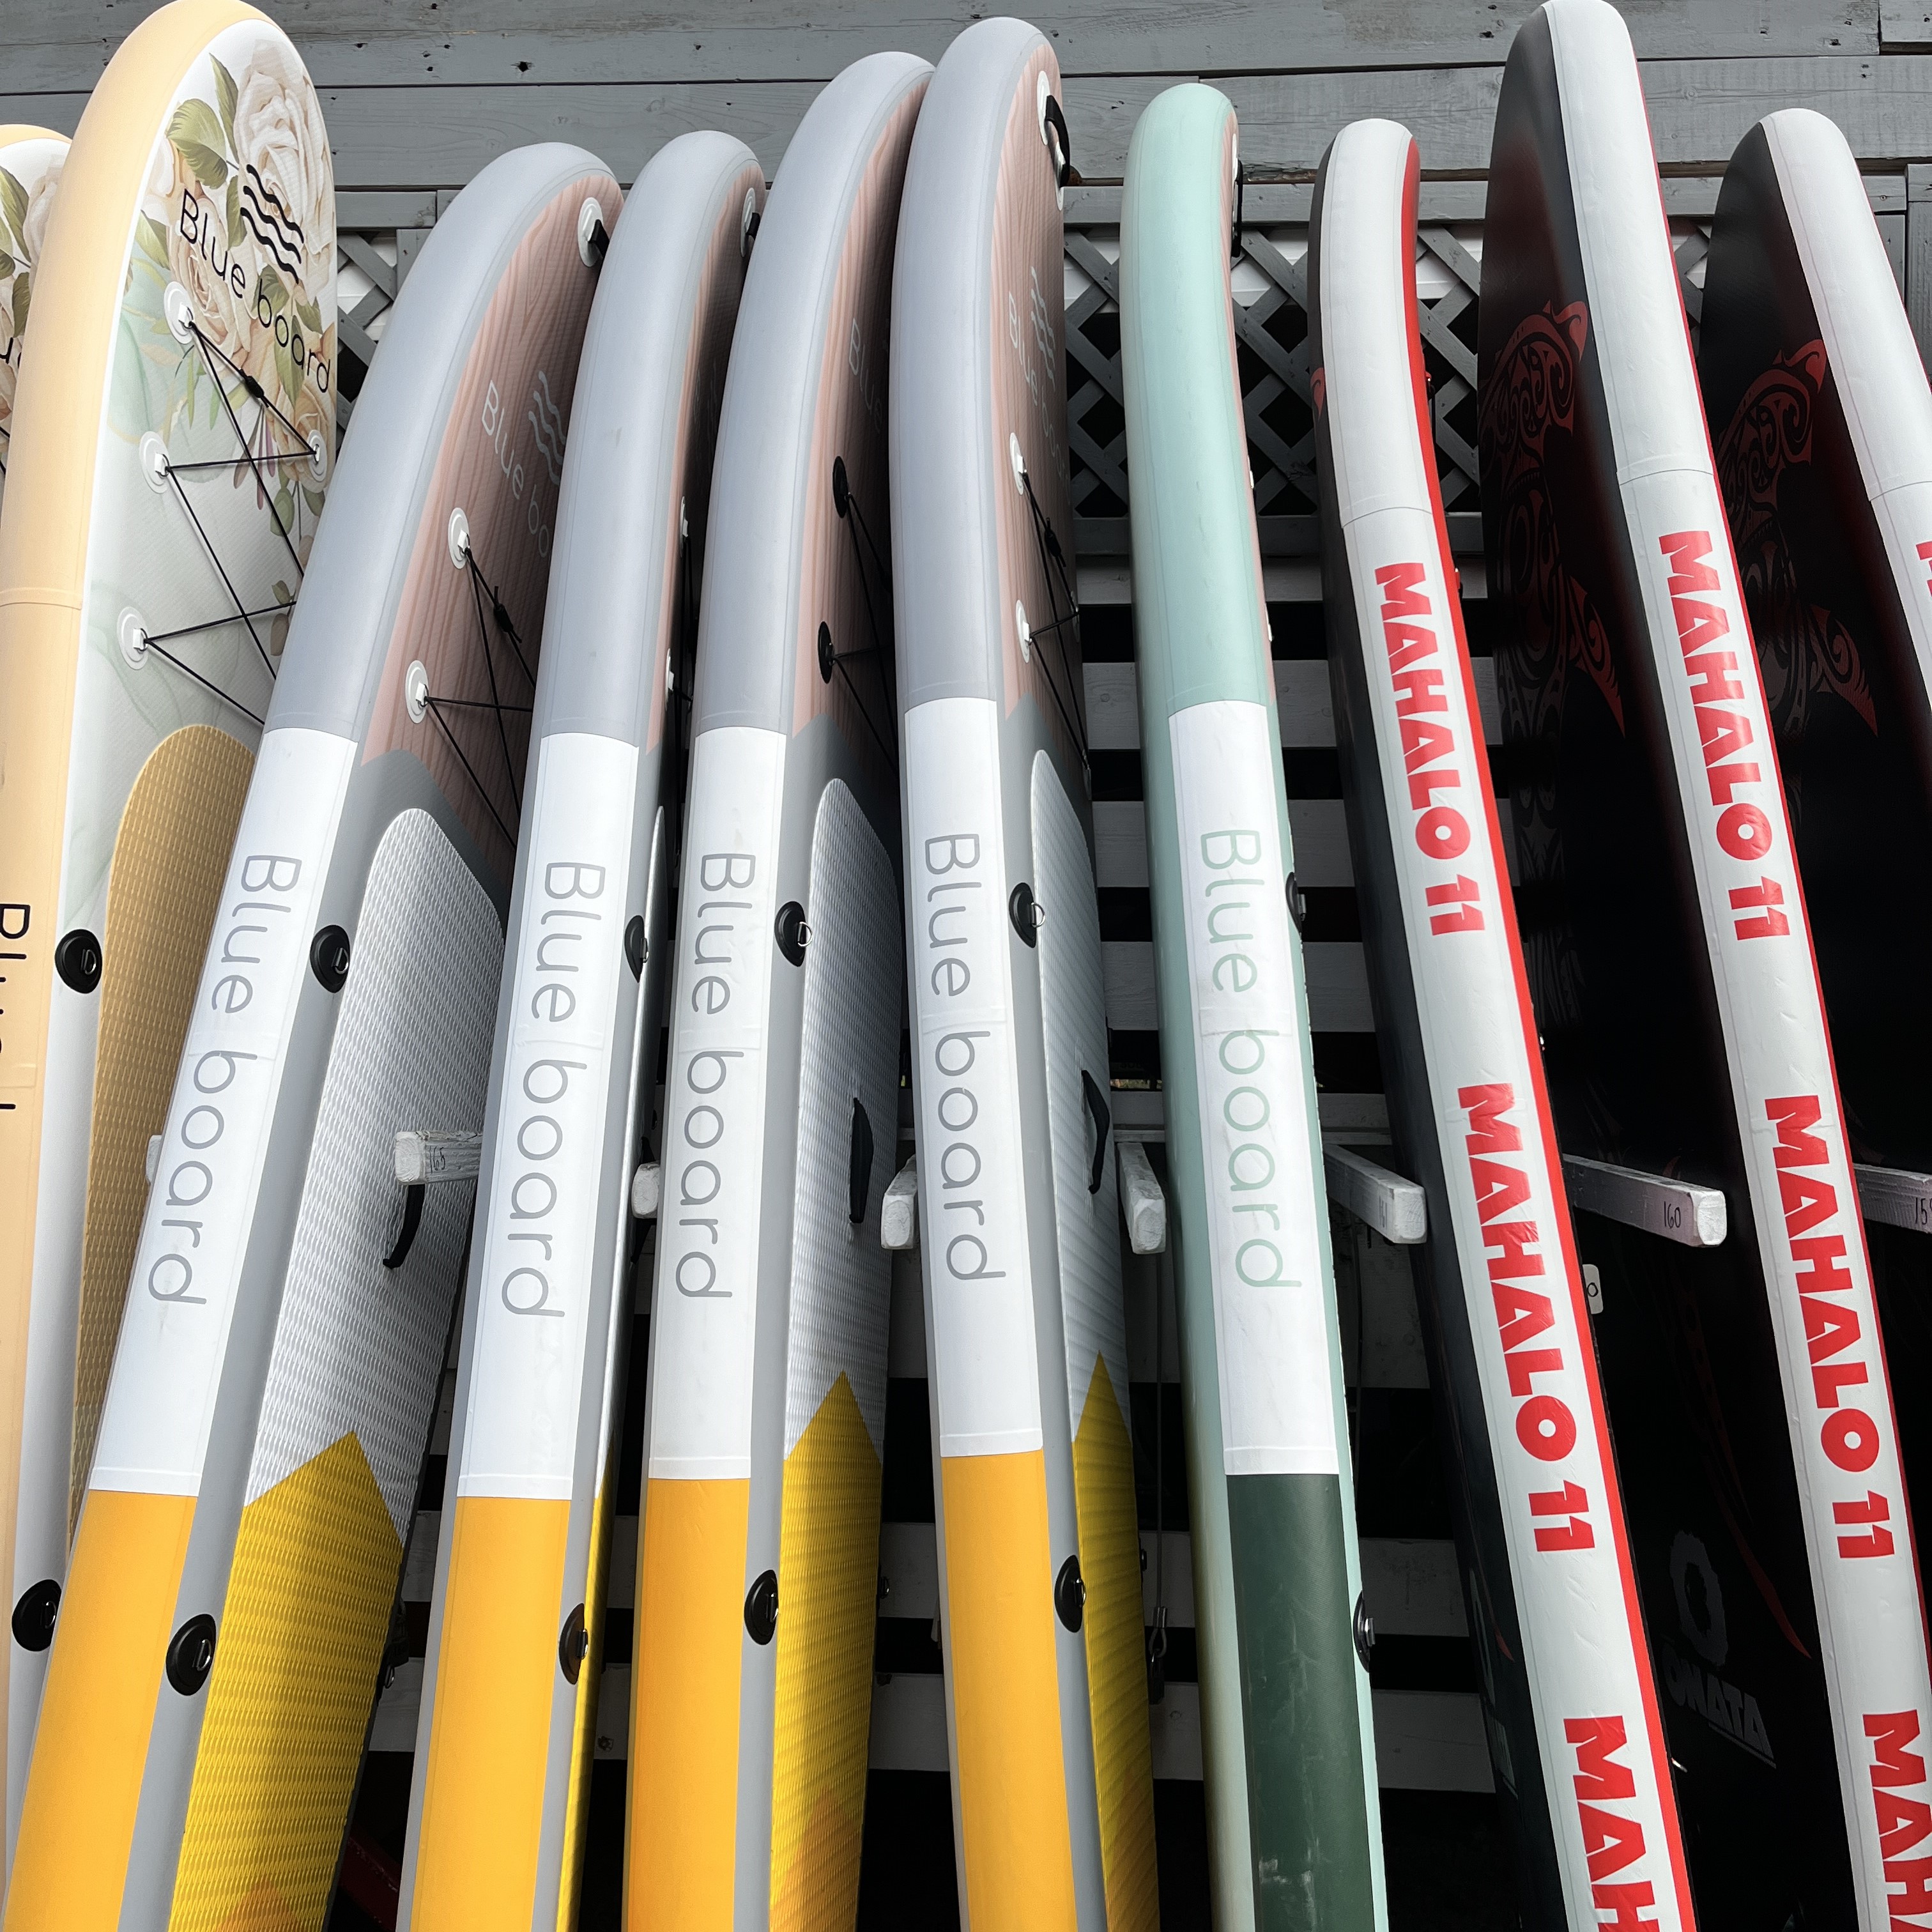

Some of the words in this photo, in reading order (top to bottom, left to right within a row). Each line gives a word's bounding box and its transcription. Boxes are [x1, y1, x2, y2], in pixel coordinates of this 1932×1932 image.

[180, 189, 245, 298] Blue
[256, 279, 331, 393] board
[849, 318, 882, 434] Blue
[1009, 291, 1038, 406] Blue
[482, 379, 524, 500] Blue
[1376, 562, 1470, 859] MAHALO
[1426, 873, 1485, 935] 11
[1659, 531, 1772, 861] MAHALO
[1728, 876, 1790, 940] 11
[211, 855, 302, 1014] Blue
[531, 862, 606, 1022] Blue
[692, 854, 756, 1015] Blue
[925, 834, 982, 997] Blue
[1201, 830, 1265, 992] Blue
[148, 1050, 258, 1305] board
[429, 1146, 446, 1174] 165
[502, 1059, 588, 1317] board
[675, 1050, 744, 1298] board
[935, 1031, 1006, 1280] board
[1219, 1030, 1302, 1287] board
[1664, 1201, 1682, 1229] 160
[1459, 1084, 1577, 1461] MAHALO
[1529, 1480, 1595, 1552] 11
[1765, 1095, 1880, 1473] MAHALO
[1832, 1490, 1895, 1558] 11
